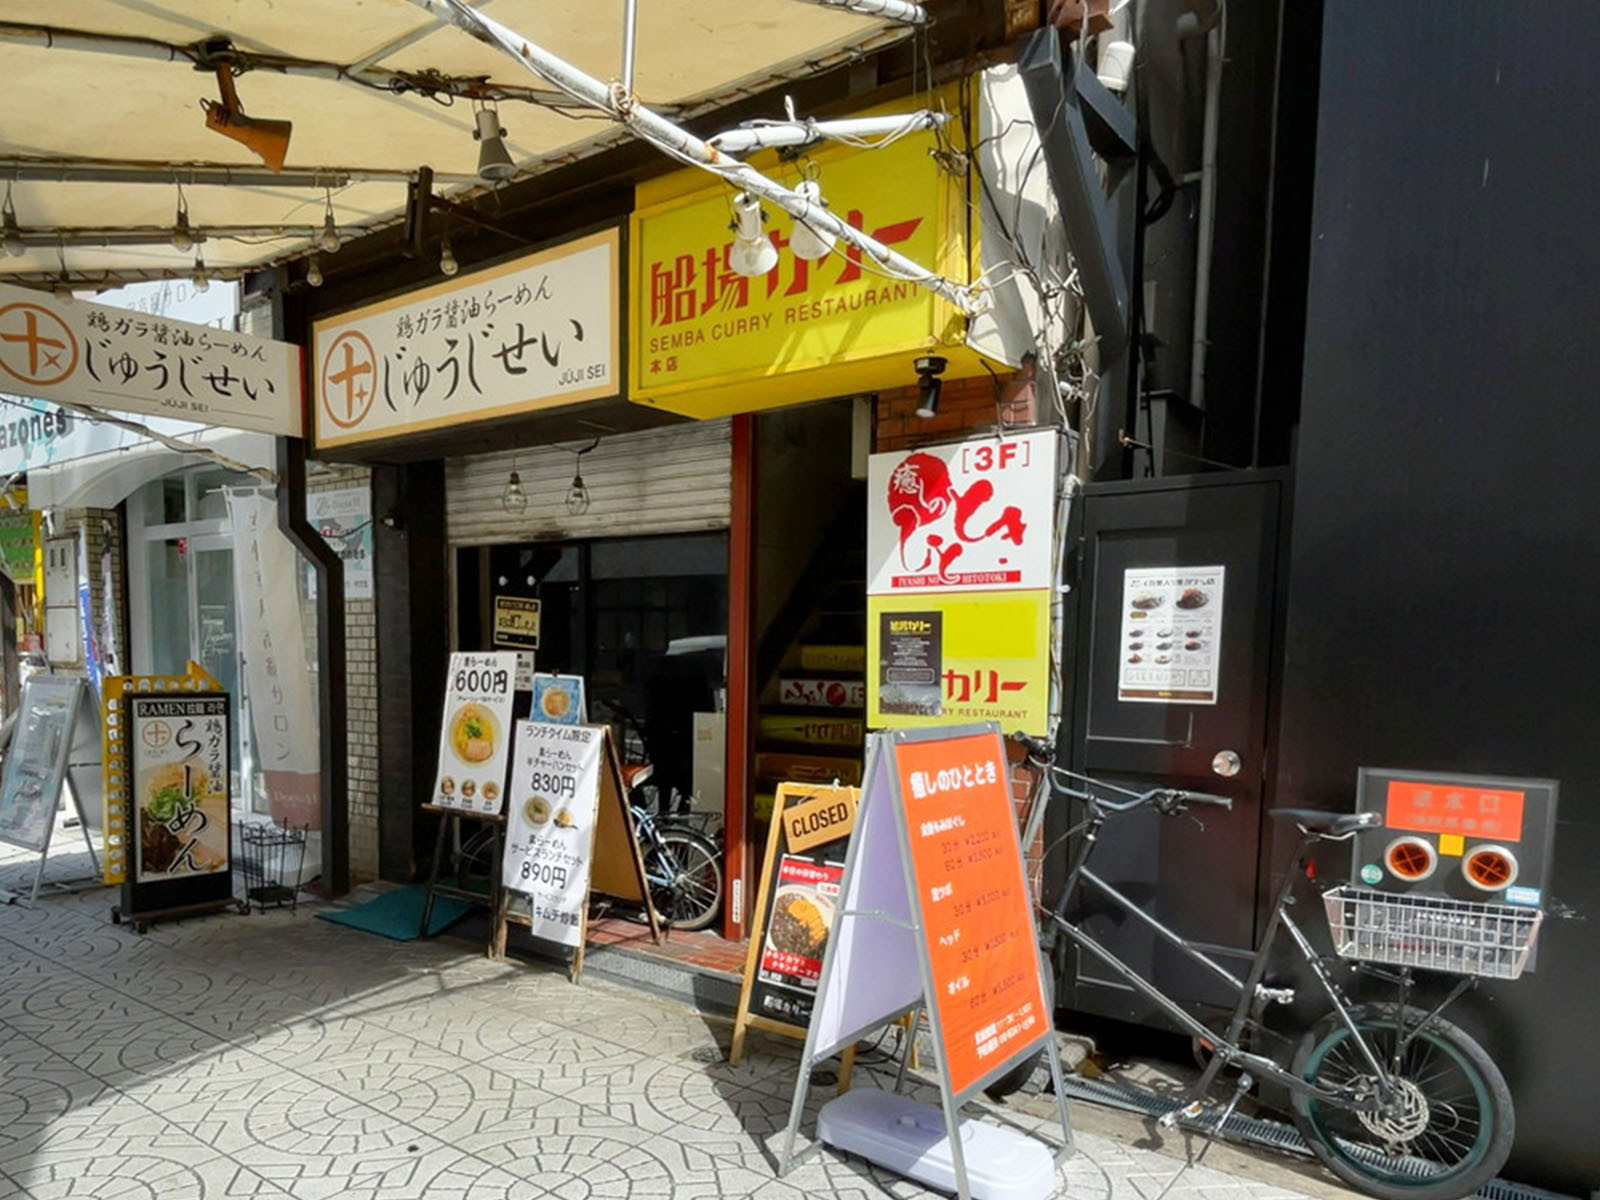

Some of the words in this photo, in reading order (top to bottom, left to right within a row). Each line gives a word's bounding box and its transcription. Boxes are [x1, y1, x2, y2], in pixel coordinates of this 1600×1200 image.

[395, 274, 553, 340] 鶏ガラ醤油らーめん
[649, 324, 705, 354] SEMBA
[711, 312, 773, 341] CURRY
[784, 282, 920, 324] RESTAURANT
[86, 311, 268, 363] 鶏ガラ醤油らーめん
[587, 364, 606, 380] SEI
[650, 356, 678, 375] 本店
[190, 401, 209, 413] SEI
[456, 669, 508, 694] 600円
[139, 702, 186, 717] RAMEN
[958, 708, 1029, 719] RESTAURANT
[168, 719, 207, 873] らーめん
[531, 772, 576, 799] 830円
[791, 802, 848, 839] CLOSED
[521, 861, 567, 889] 890円
